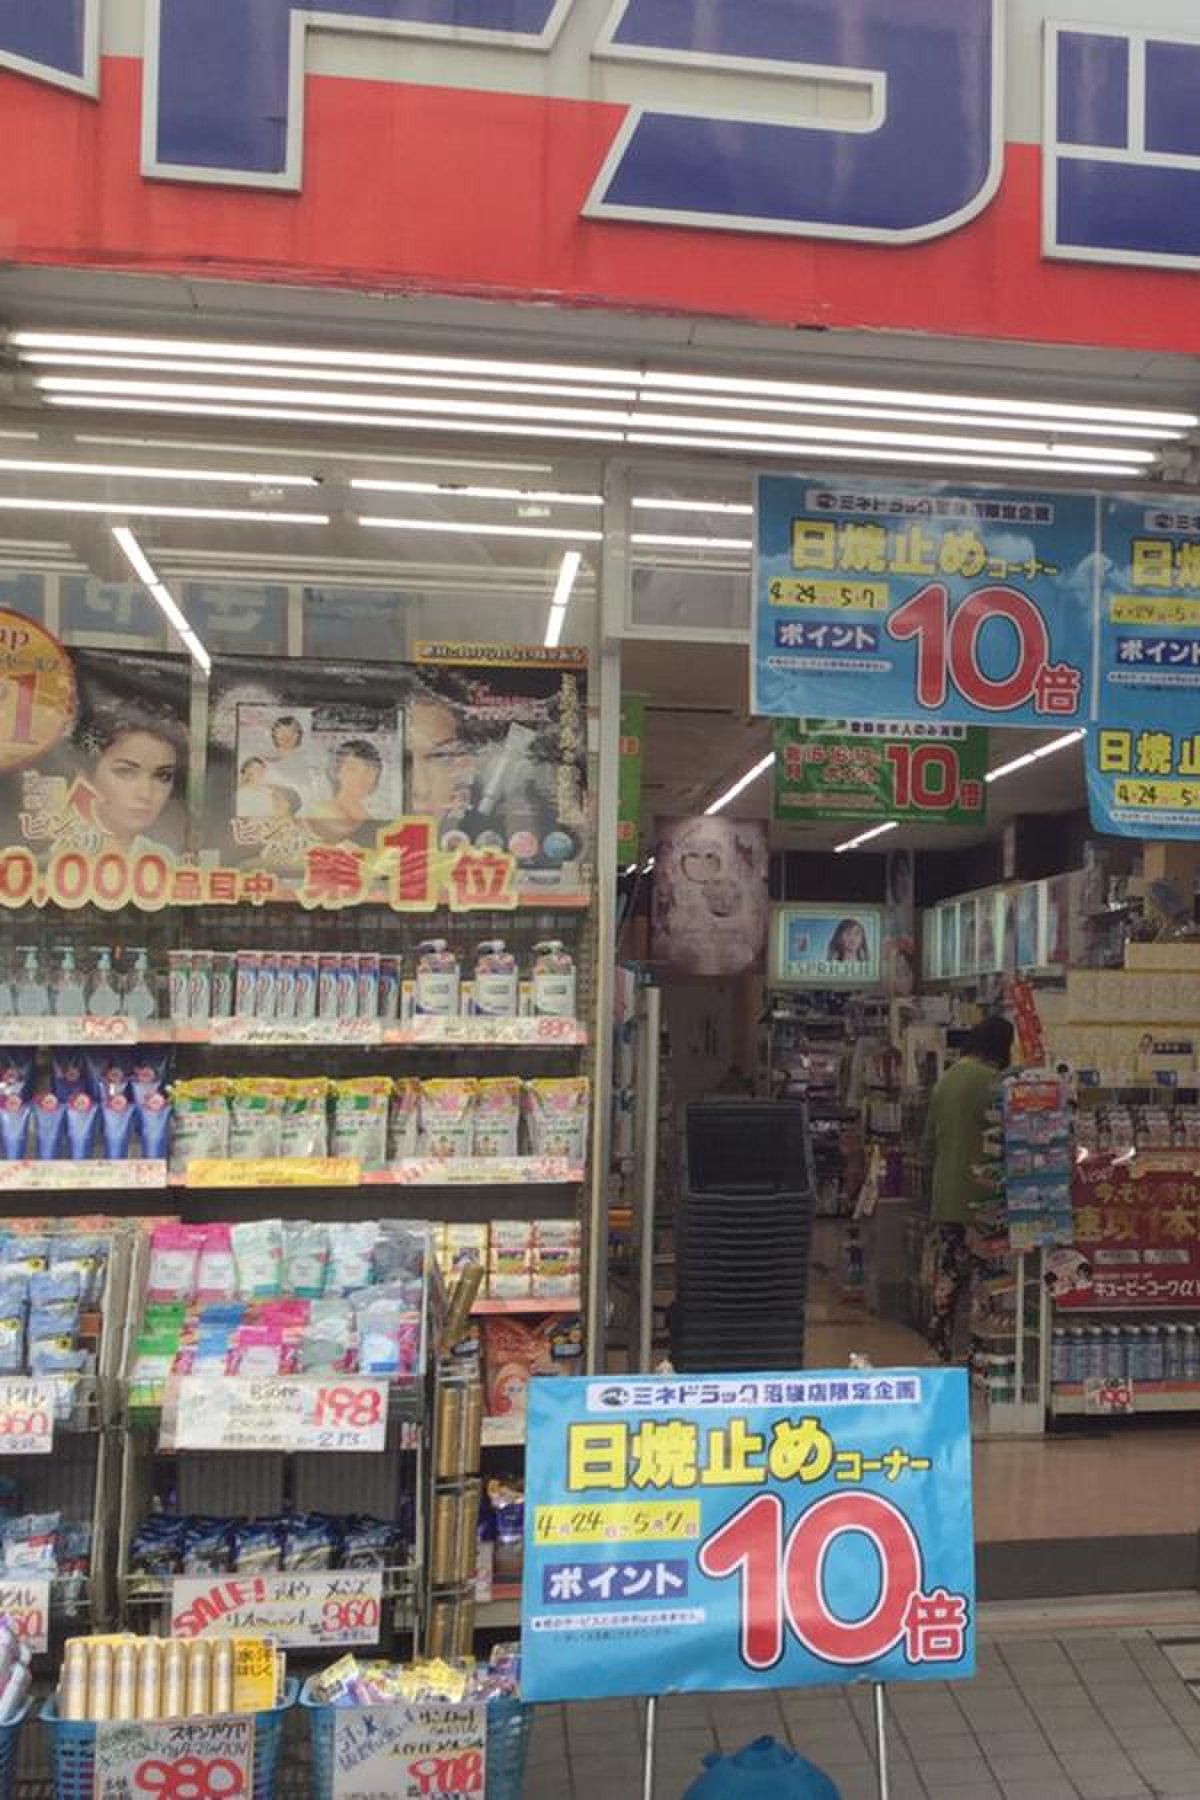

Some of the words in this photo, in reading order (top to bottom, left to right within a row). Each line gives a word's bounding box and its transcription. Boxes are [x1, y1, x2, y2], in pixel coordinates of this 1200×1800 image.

[778, 620, 877, 650] ポイント
[312, 1384, 381, 1427] 198
[550, 1562, 685, 1601] ポイント
[133, 1755, 245, 1800] 980
